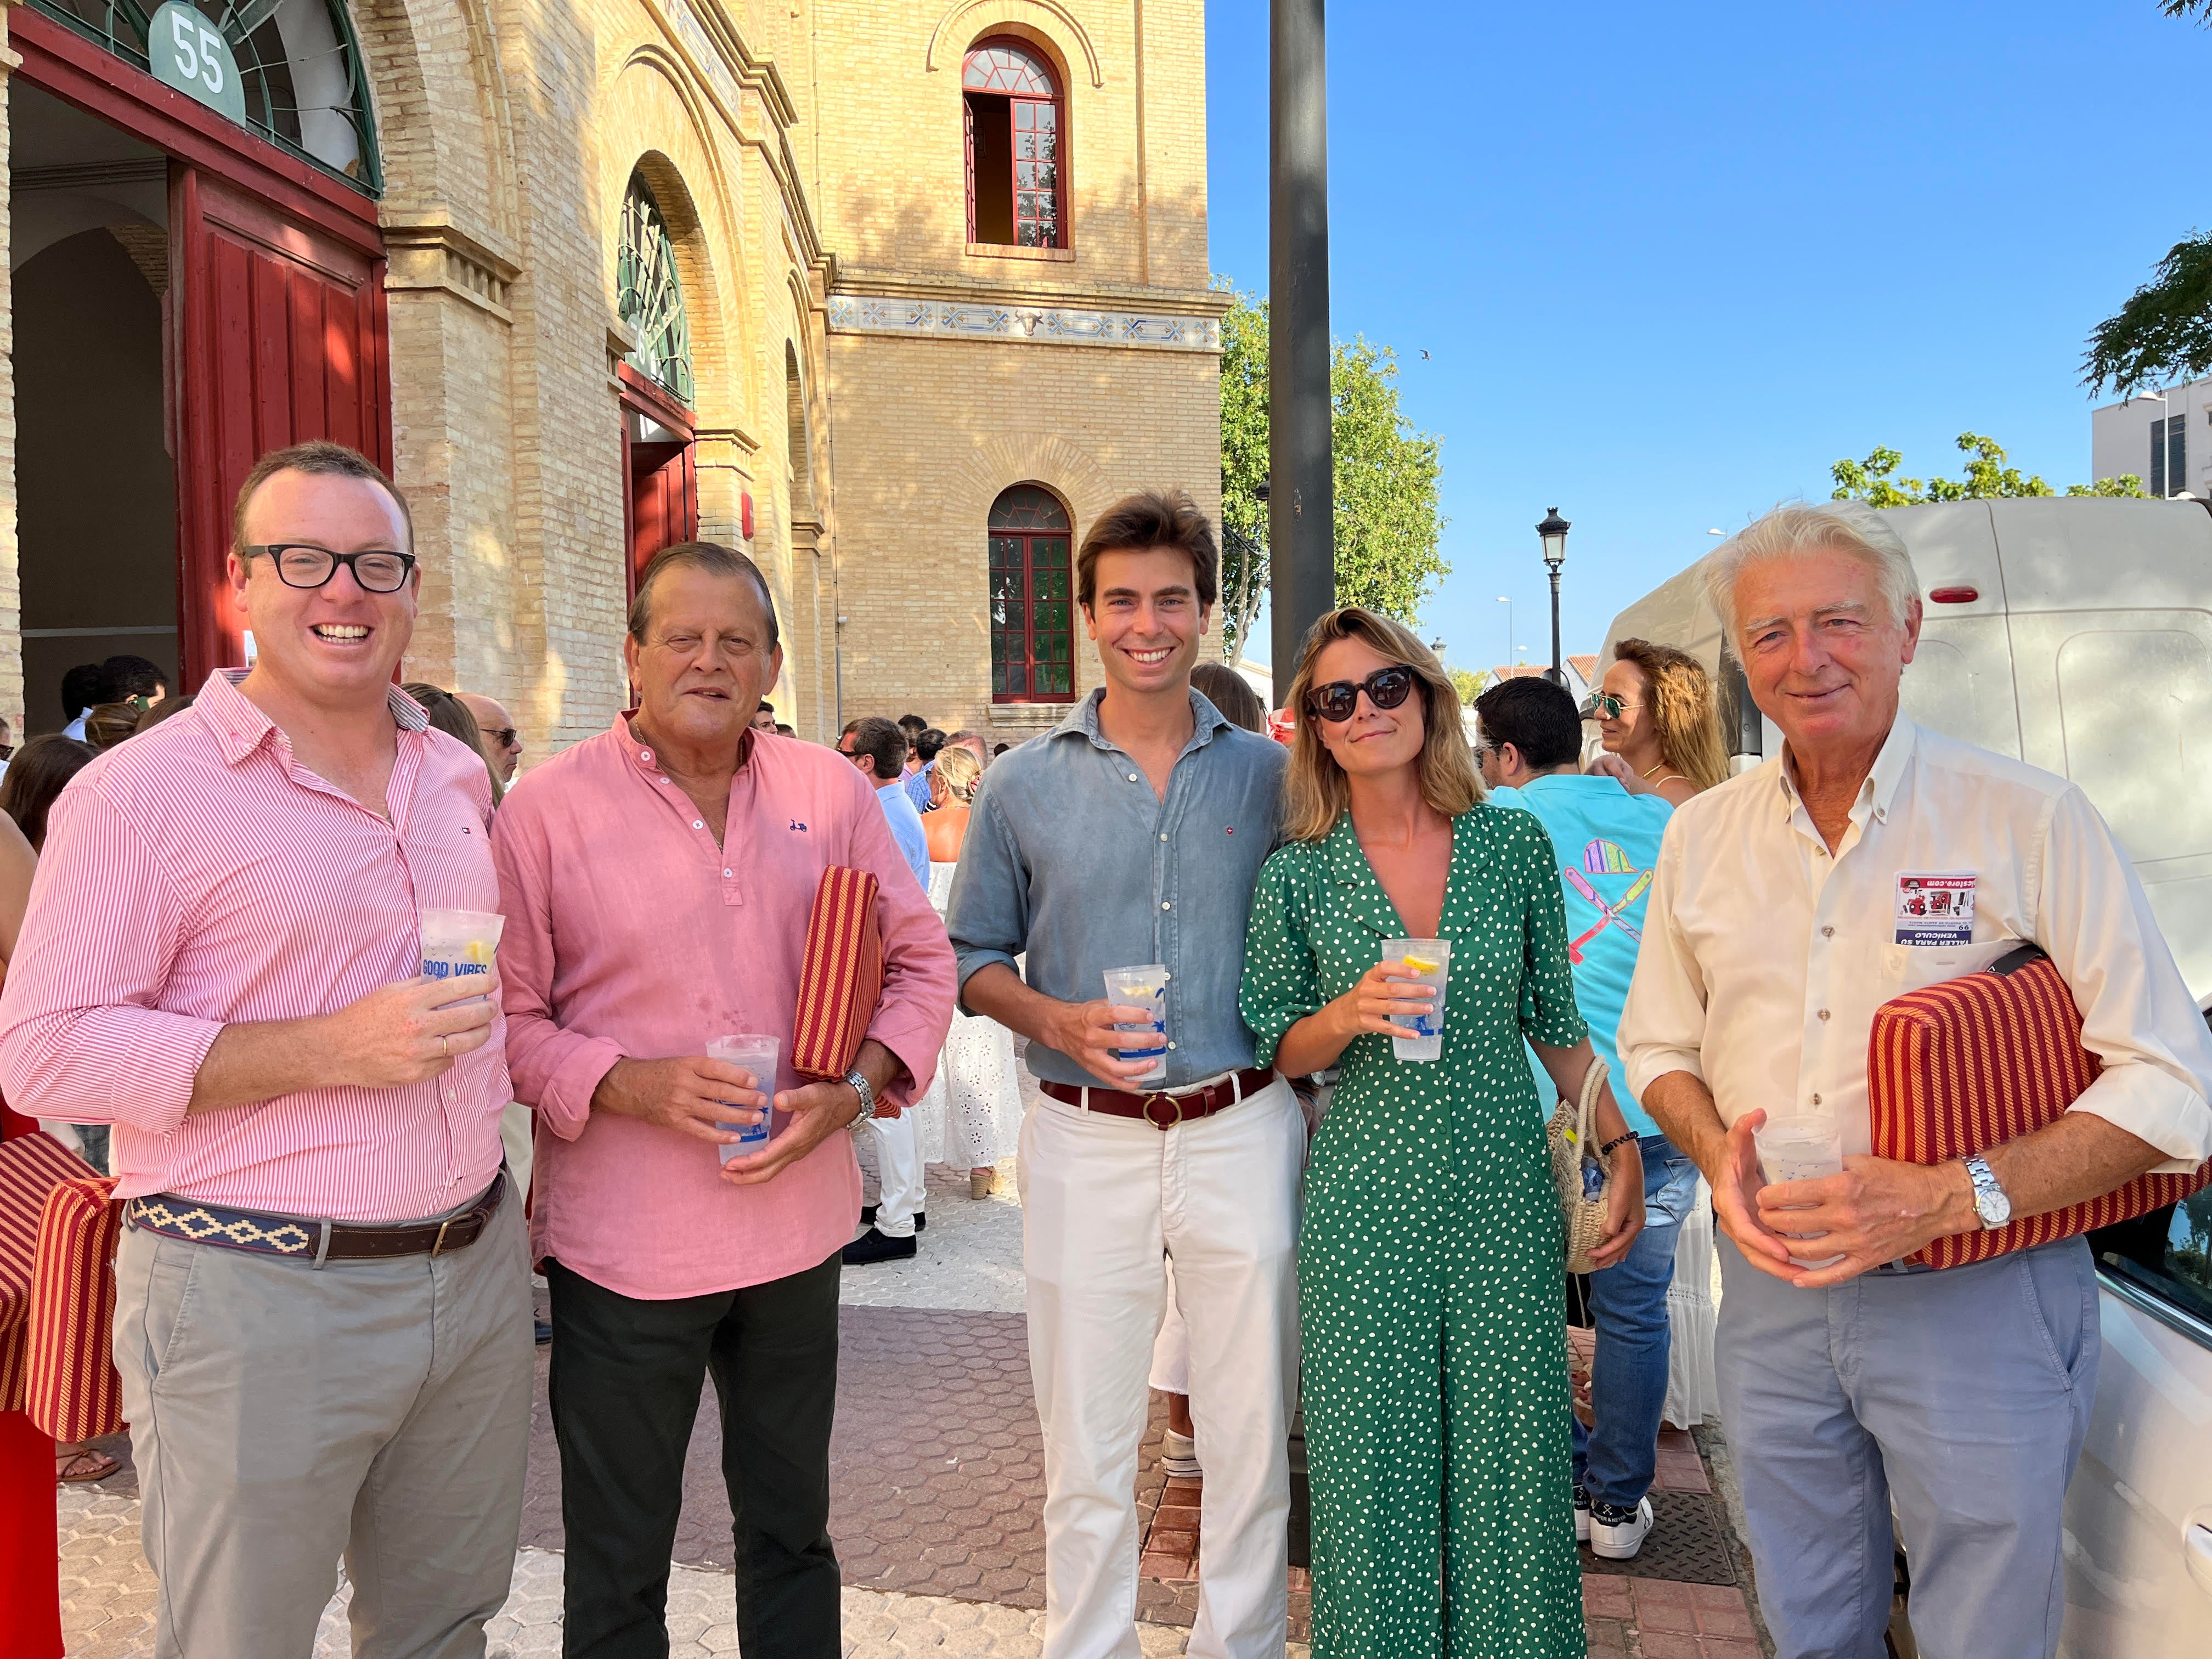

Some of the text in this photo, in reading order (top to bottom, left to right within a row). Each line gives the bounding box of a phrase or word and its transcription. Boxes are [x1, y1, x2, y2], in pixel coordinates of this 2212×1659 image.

[171, 10, 223, 94] 55
[423, 959, 487, 977] GOOD VIBES
